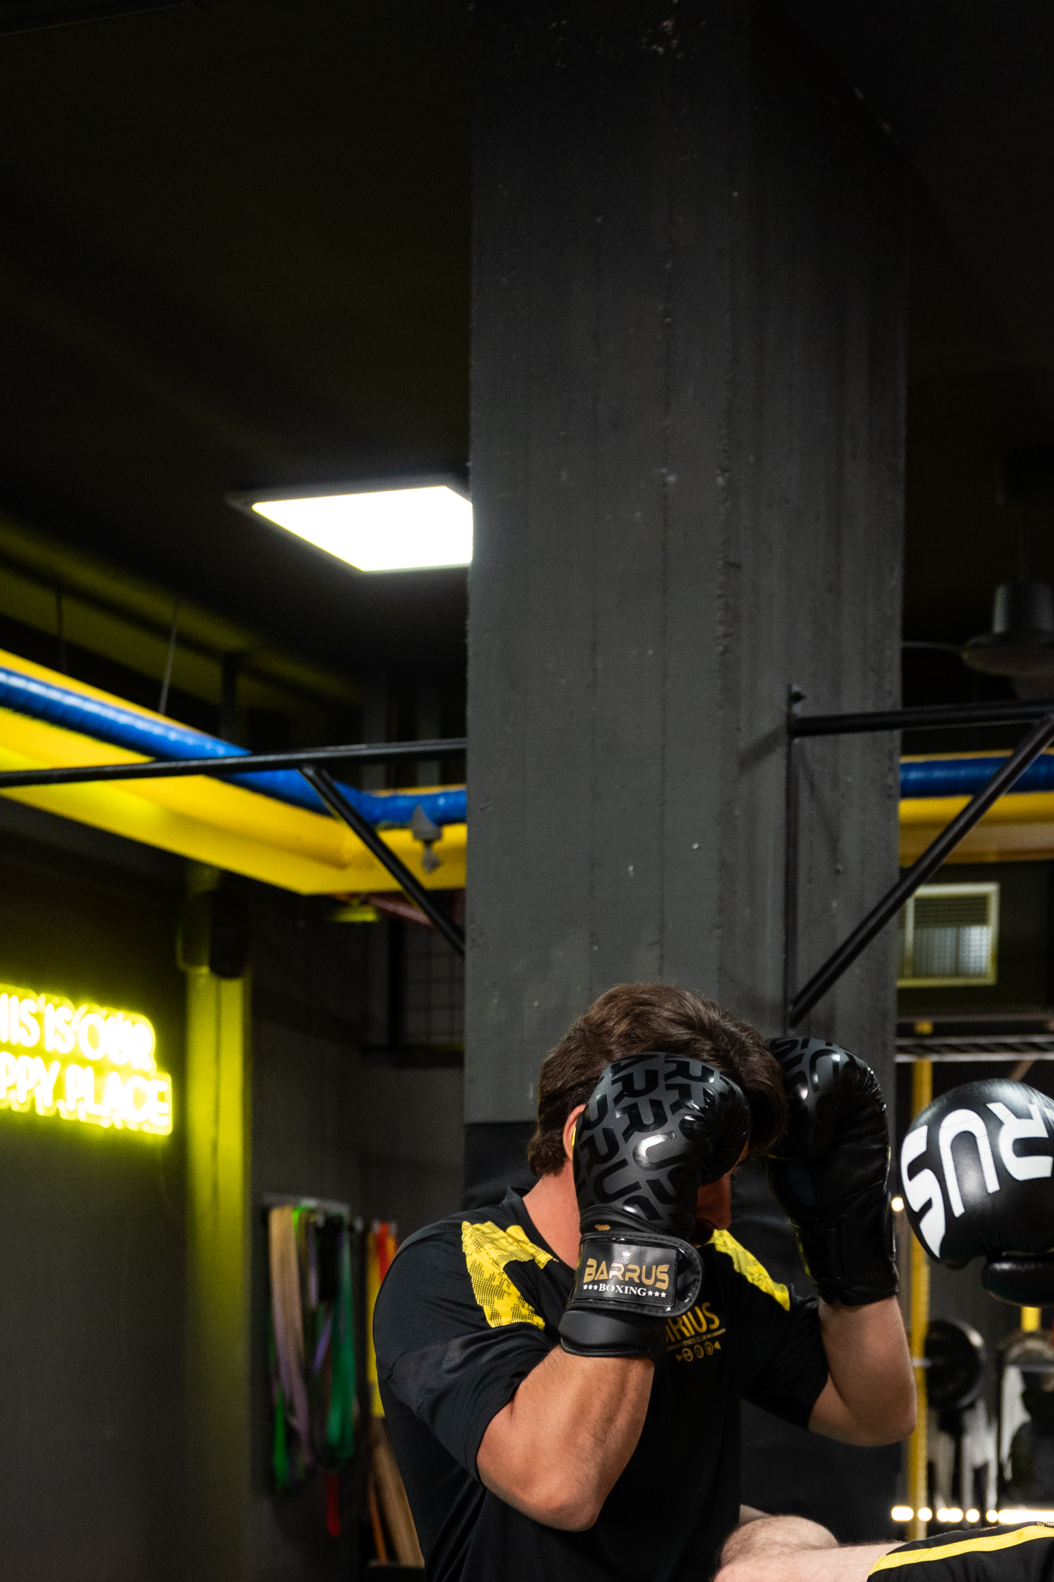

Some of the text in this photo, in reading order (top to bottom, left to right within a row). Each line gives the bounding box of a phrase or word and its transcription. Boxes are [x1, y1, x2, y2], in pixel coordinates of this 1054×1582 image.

[44, 1002, 76, 1054] IS
[77, 1012, 152, 1072] OUR
[65, 1063, 171, 1128] PLACE
[583, 1258, 670, 1291] BARRUS
[598, 1283, 647, 1298] BOXING
[666, 1302, 720, 1343] IRIUS
